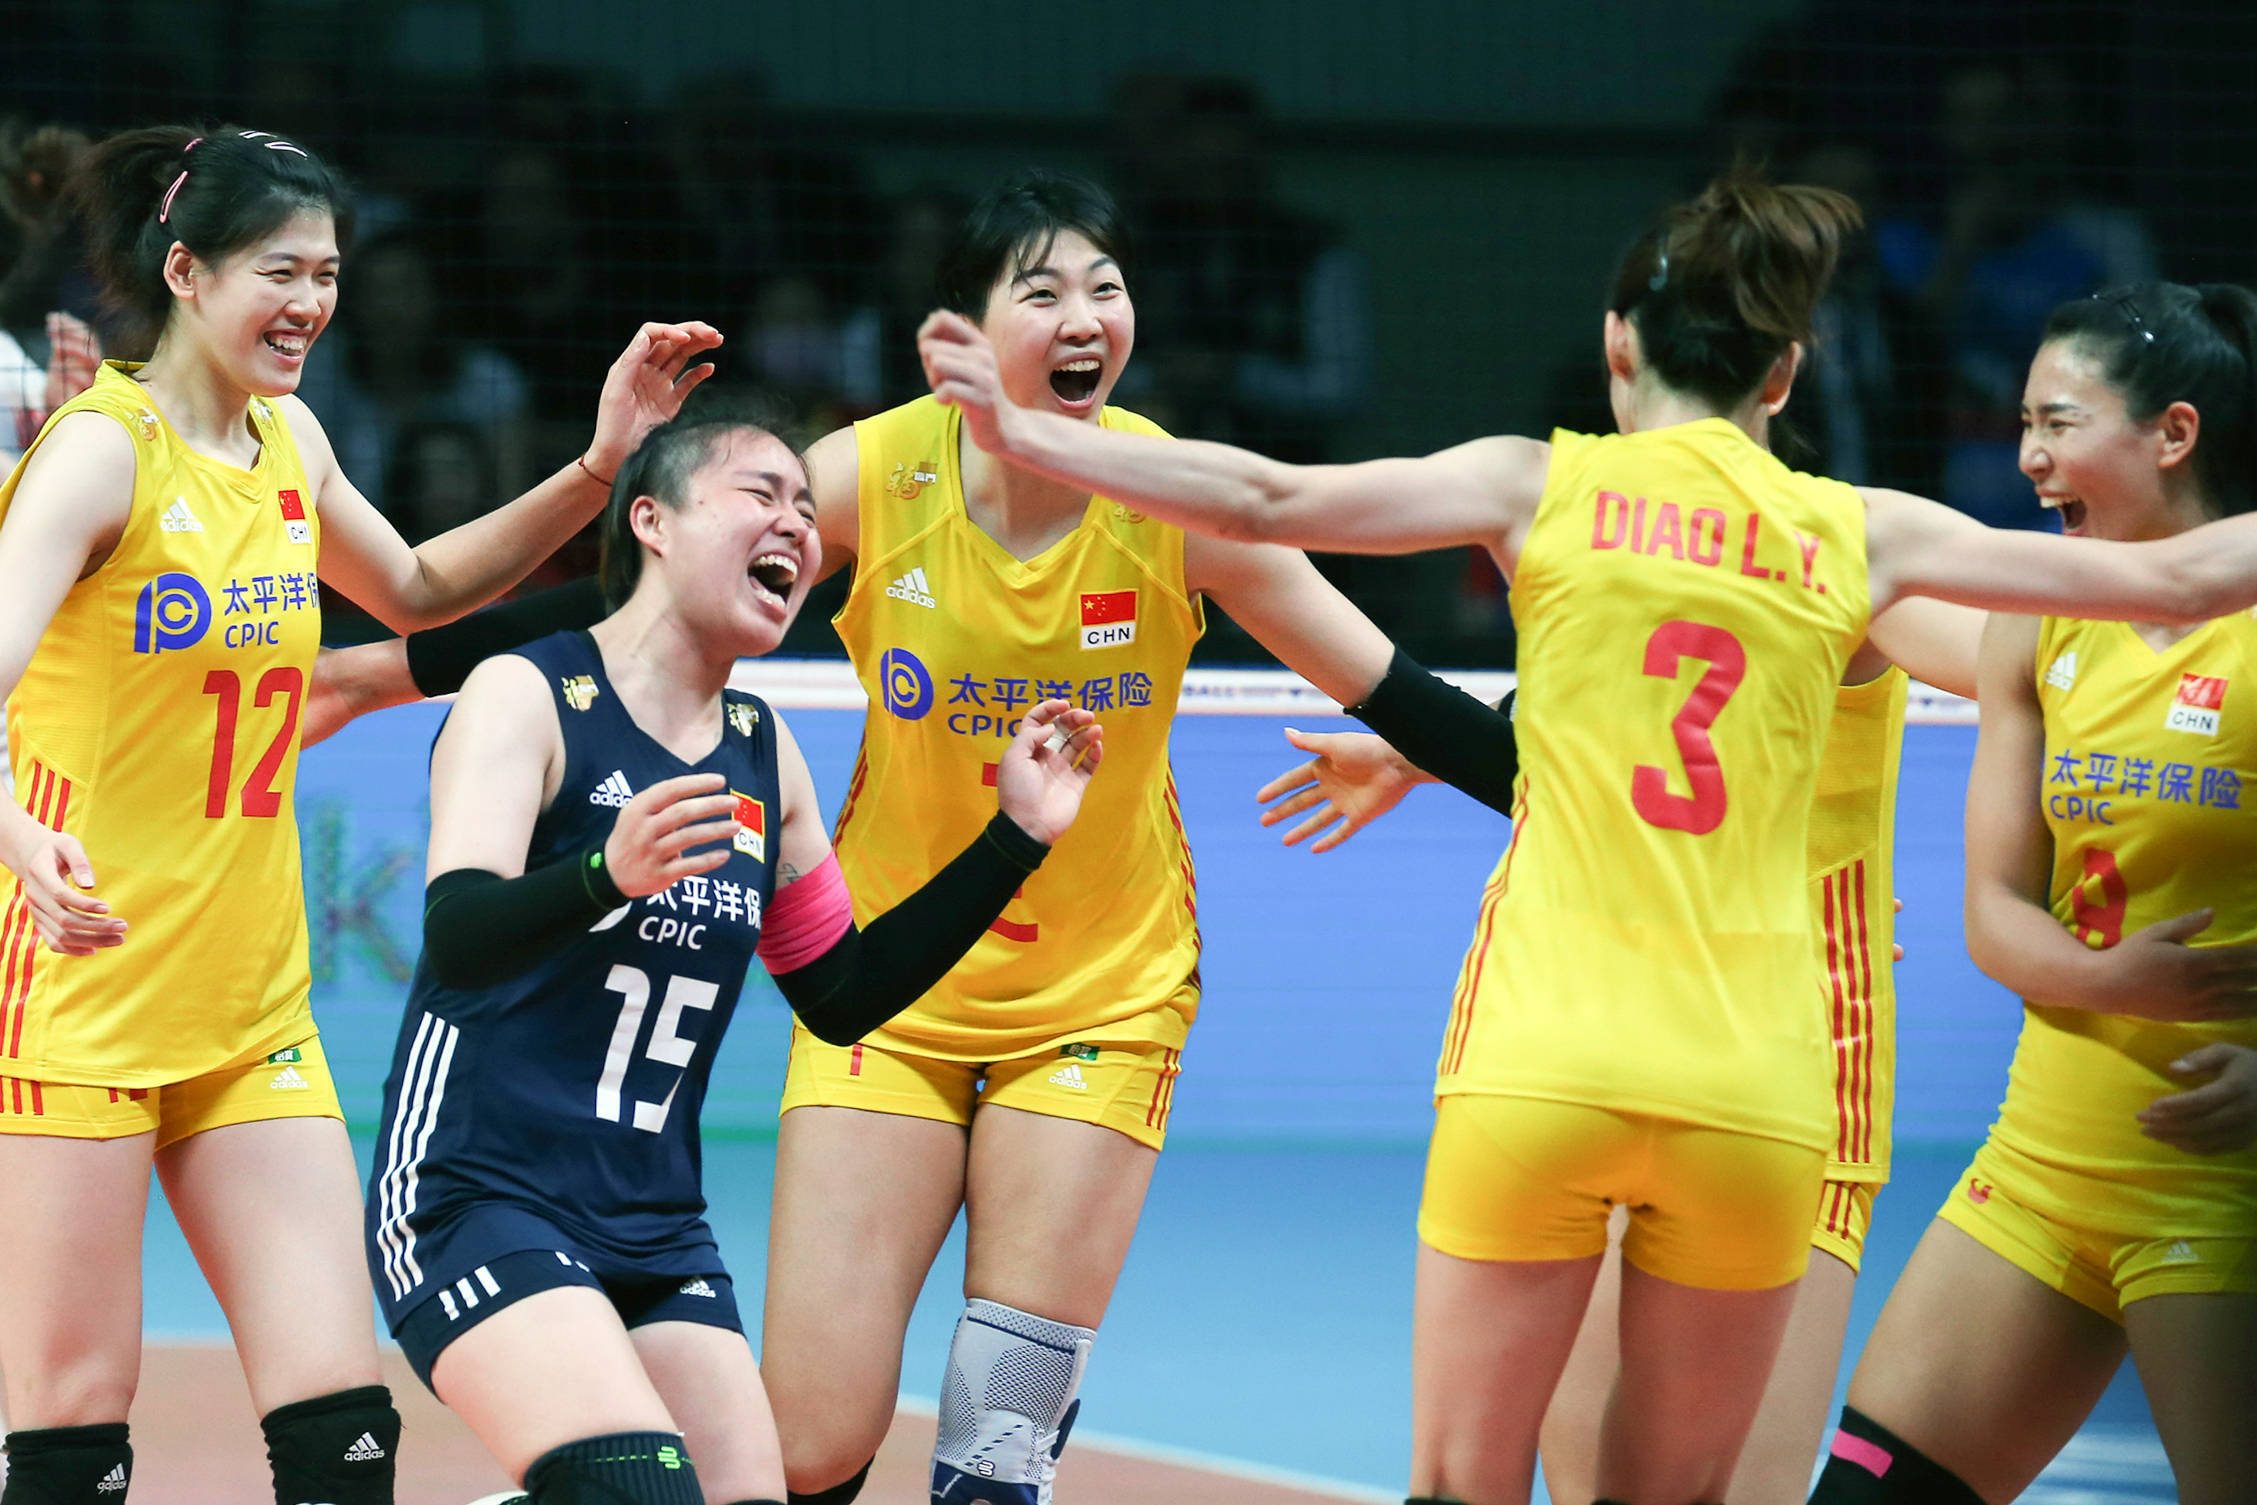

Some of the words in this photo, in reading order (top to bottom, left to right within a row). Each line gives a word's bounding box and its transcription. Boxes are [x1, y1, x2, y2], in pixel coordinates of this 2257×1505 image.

[1591, 490, 1726, 568] DIAO
[886, 586, 936, 609] adidas
[225, 621, 280, 649] CPIC
[1087, 627, 1130, 645] CHN
[948, 671, 1153, 712] 太平洋保险
[1631, 619, 1747, 836] 3
[2172, 711, 2214, 731] CHN
[202, 666, 304, 819] 12
[2050, 749, 2243, 810] 太平洋保险
[2050, 795, 2115, 826] CPIC
[638, 915, 707, 951] CPIC
[595, 963, 720, 1135] 15
[344, 1449, 385, 1461] adidas
